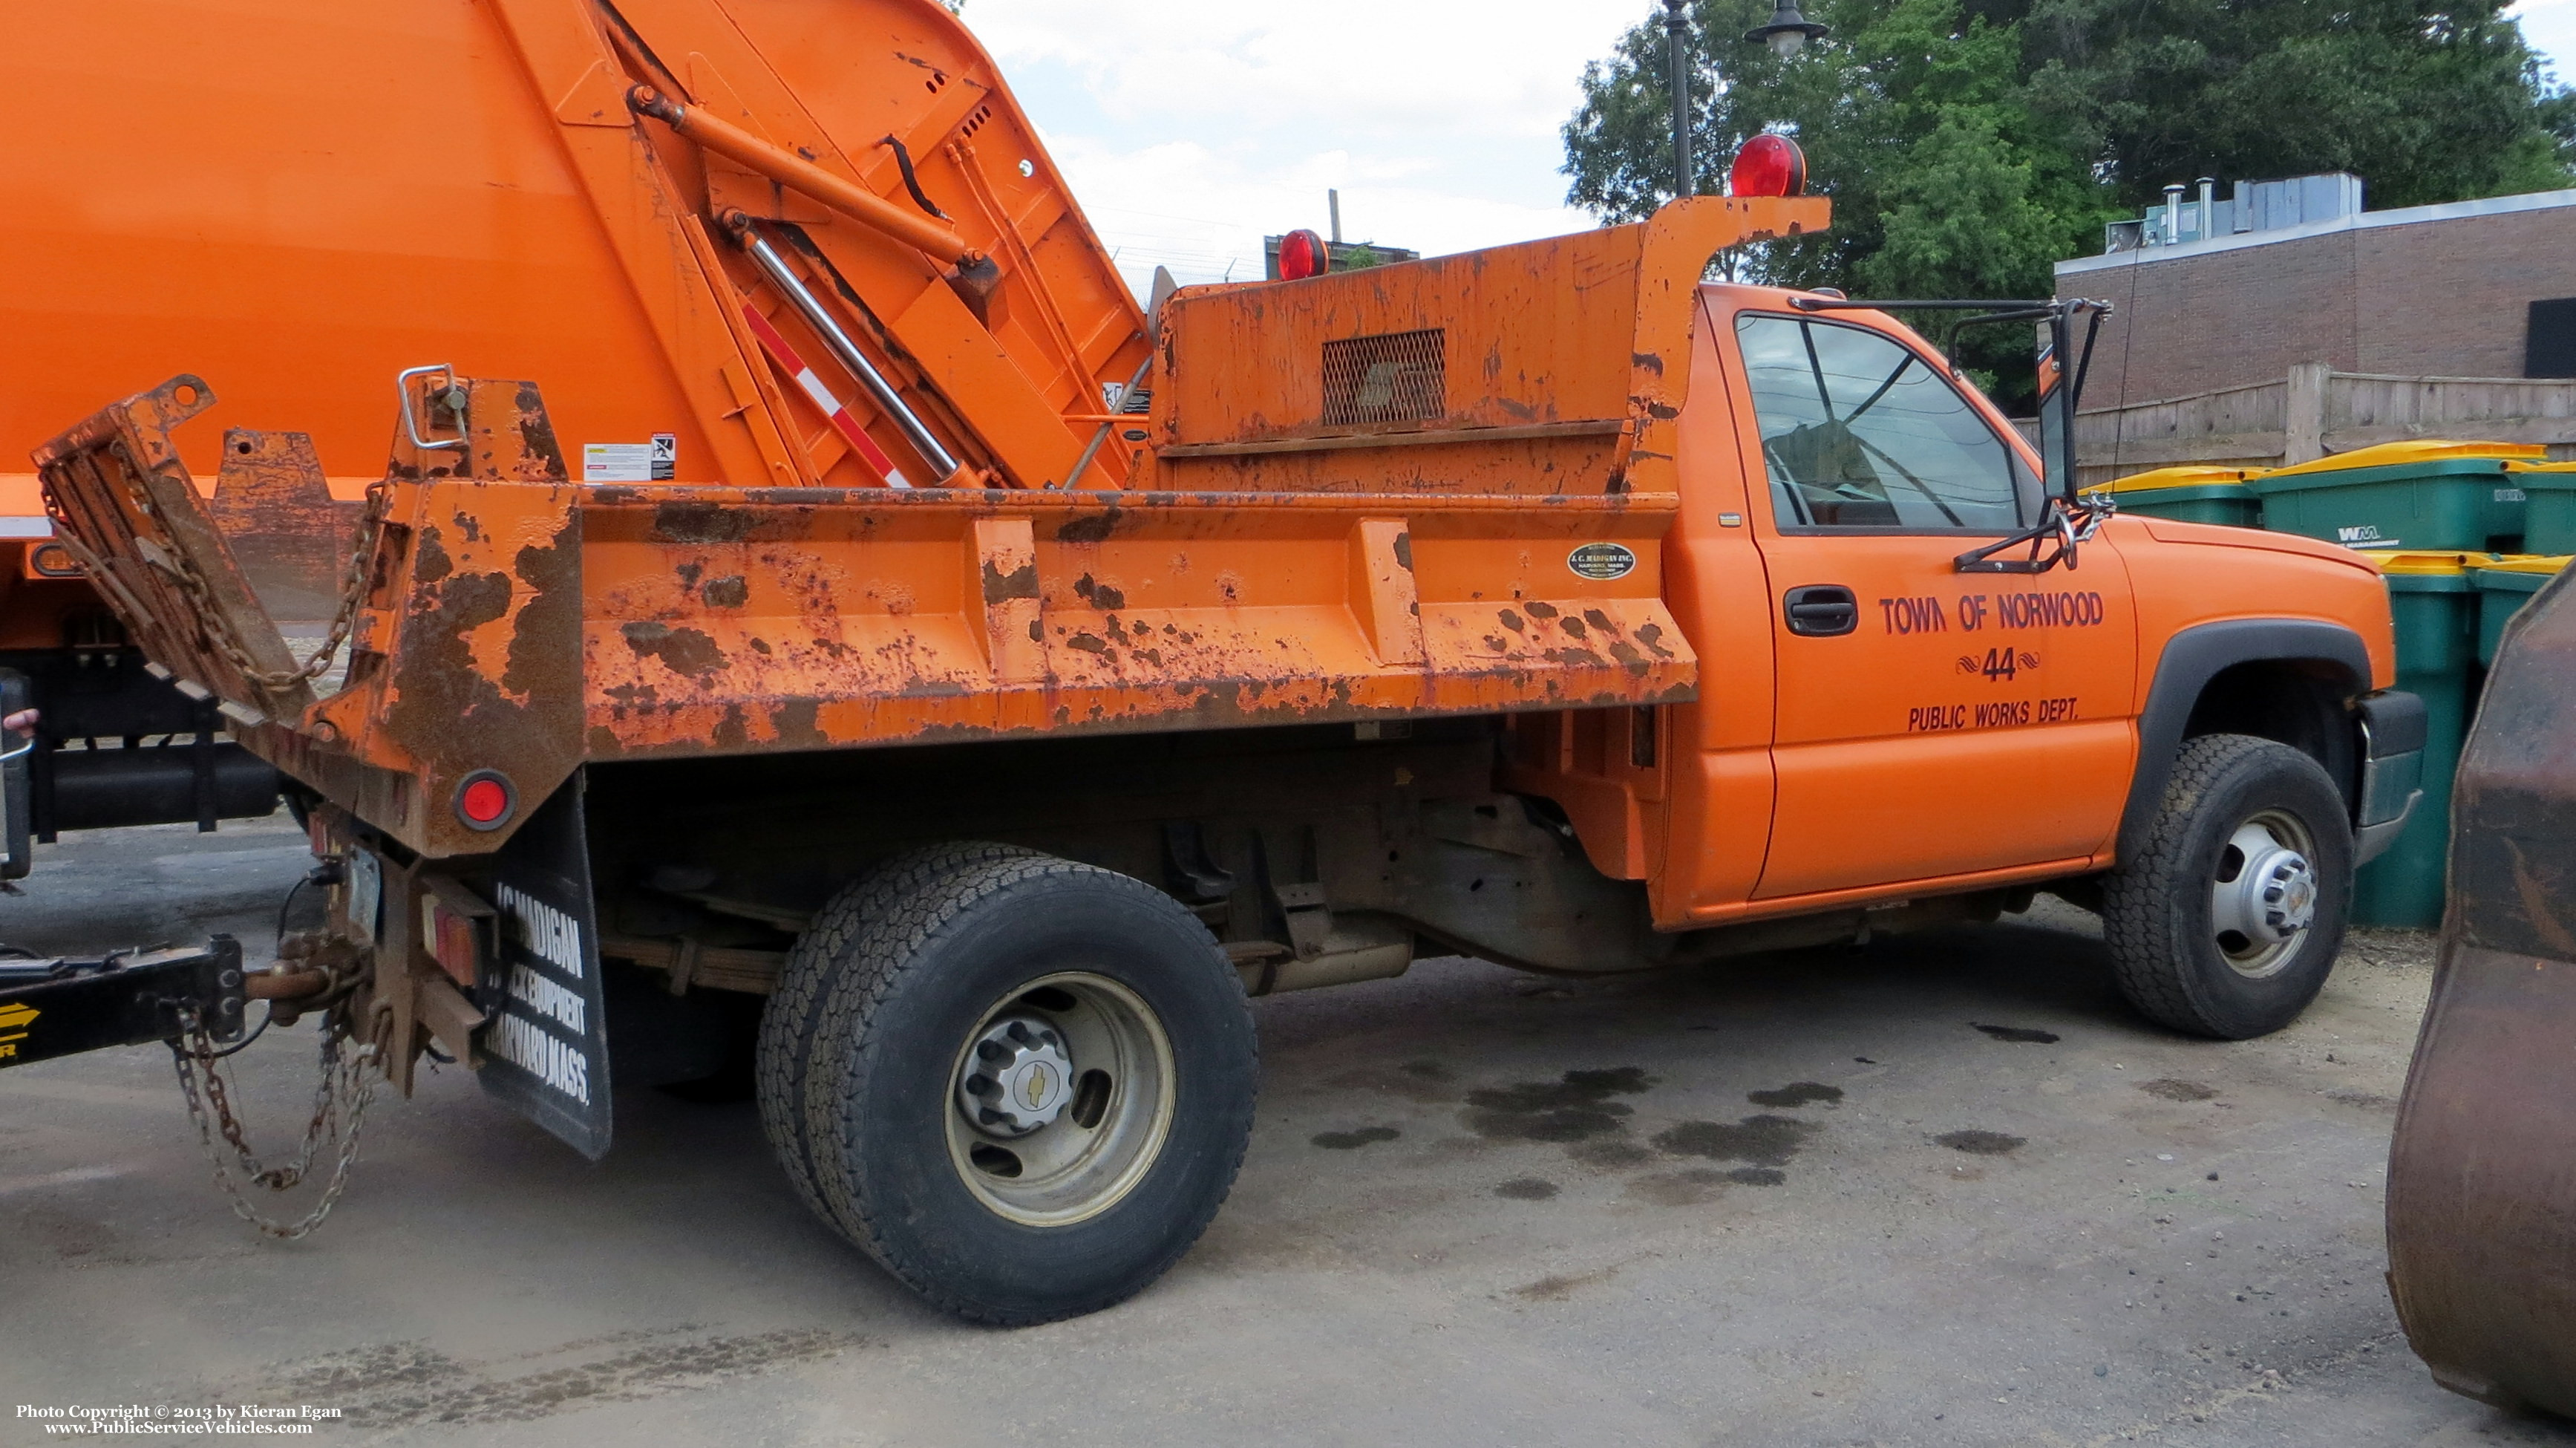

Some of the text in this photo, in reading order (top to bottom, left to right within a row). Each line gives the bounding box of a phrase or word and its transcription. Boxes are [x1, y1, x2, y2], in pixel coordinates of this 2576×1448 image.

[2338, 525, 2381, 541] WM
[1958, 594, 1987, 631] OF
[1997, 591, 2103, 629] NORWOOD
[1981, 646, 2016, 682] 44
[1908, 697, 2079, 731] PUBLIC WORKS DEPT.
